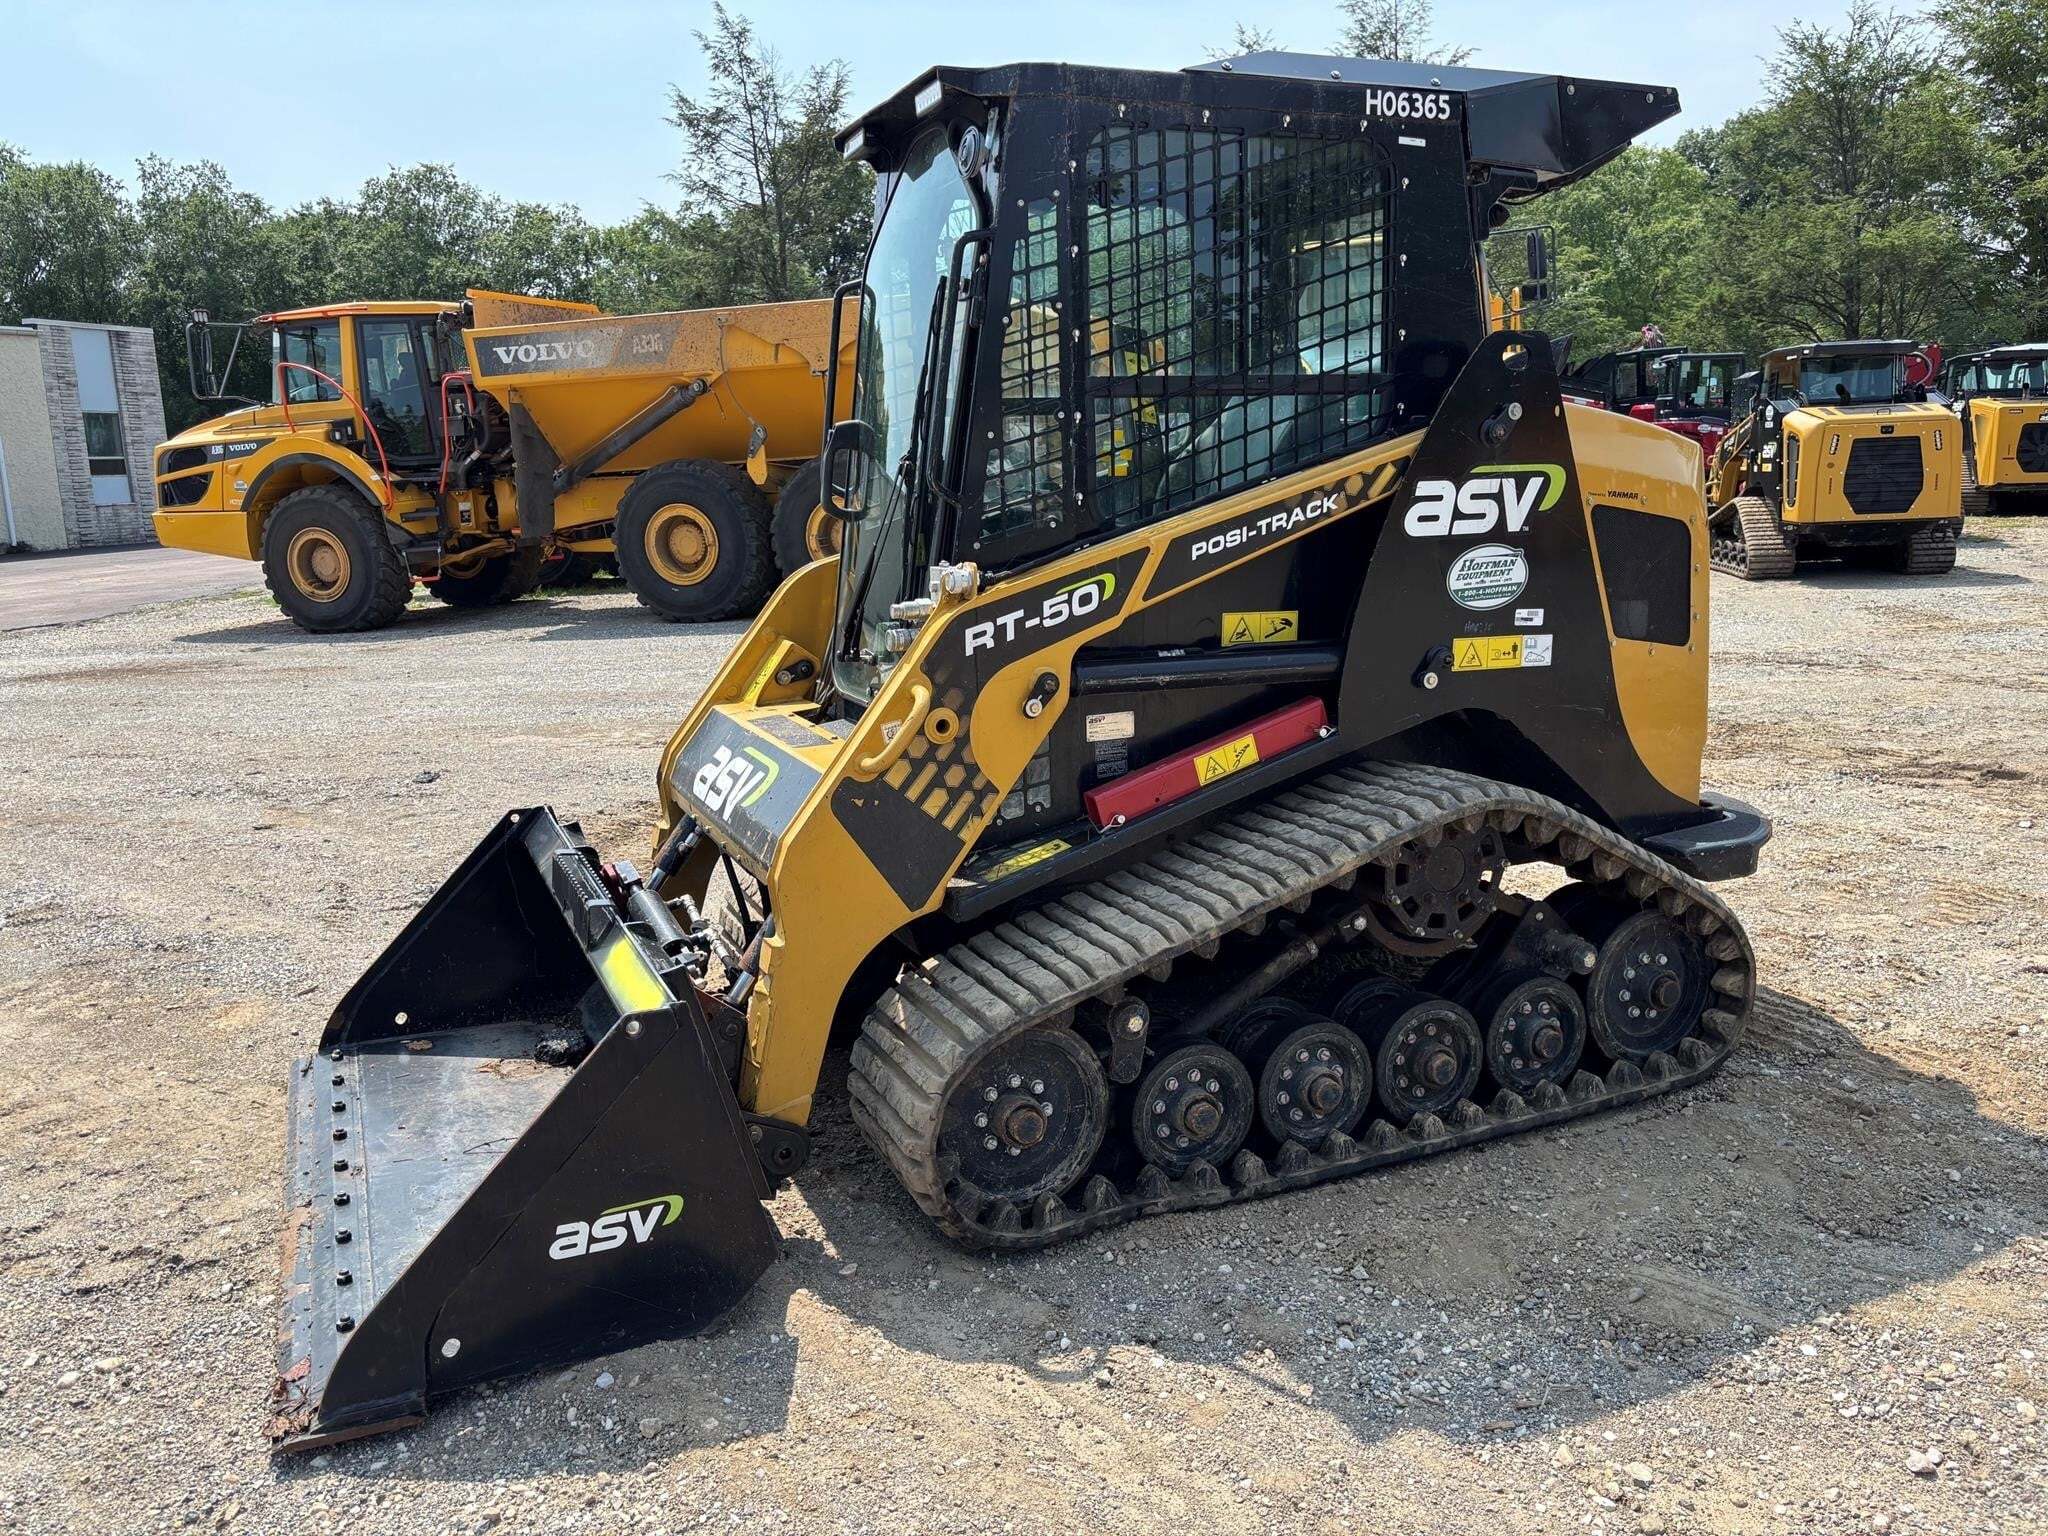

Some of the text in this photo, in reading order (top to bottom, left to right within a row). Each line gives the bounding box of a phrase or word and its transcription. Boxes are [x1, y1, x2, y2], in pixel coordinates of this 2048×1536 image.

[1365, 88, 1451, 120] H06365
[493, 339, 595, 364] VOLVO
[228, 442, 258, 453] VOLVO
[1607, 490, 1639, 500] YANMAR
[1191, 493, 1339, 561] POSI-TRACK
[1455, 568, 1514, 581] EQUIPMENT
[1459, 559, 1517, 572] HOFFMAN
[964, 583, 1100, 657] RT-50
[548, 1204, 666, 1261] asv
